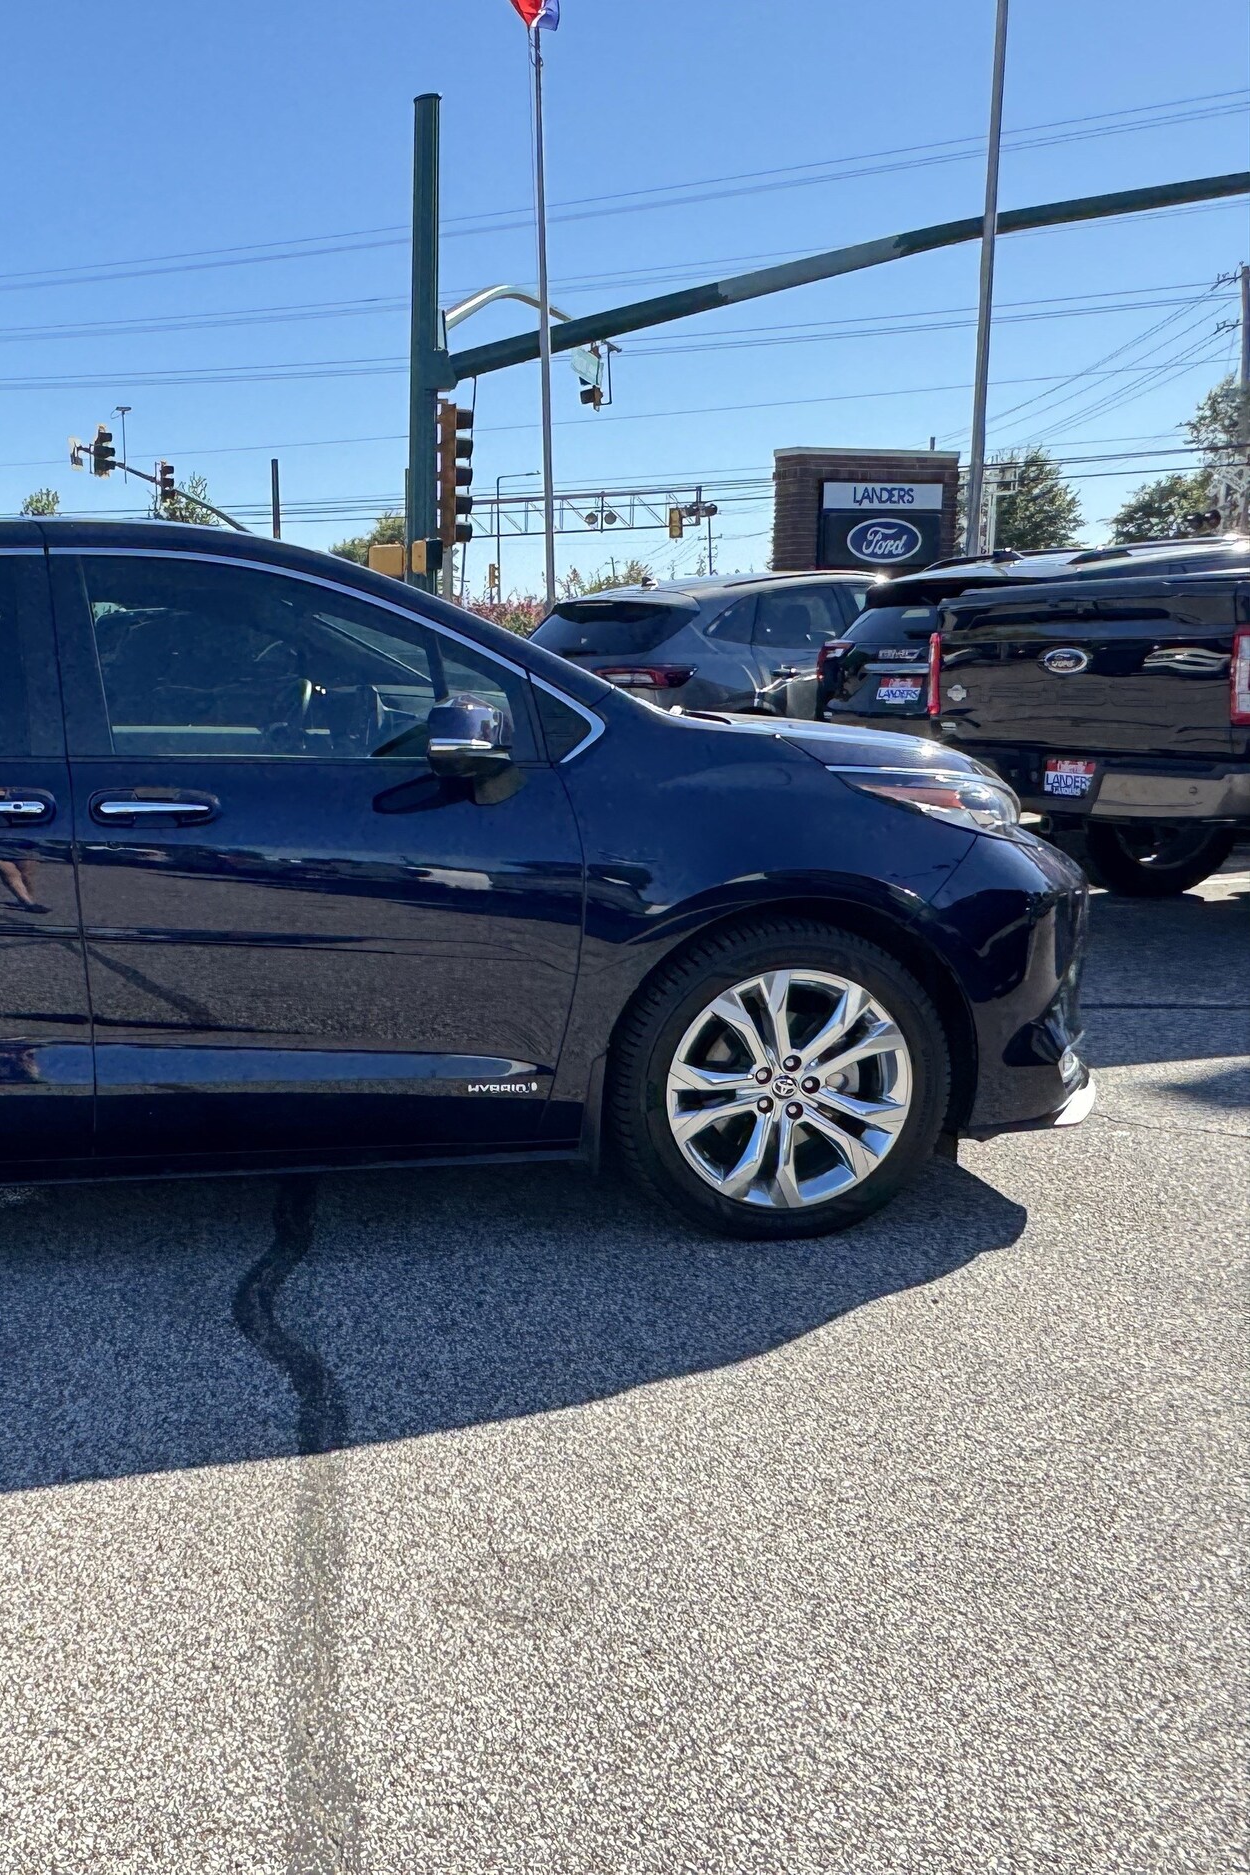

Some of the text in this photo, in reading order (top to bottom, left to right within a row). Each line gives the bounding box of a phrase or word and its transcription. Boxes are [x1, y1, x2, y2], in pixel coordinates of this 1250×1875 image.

[853, 486, 915, 506] LANDERS
[862, 526, 908, 554] Ford
[467, 1083, 528, 1093] HYBRID
